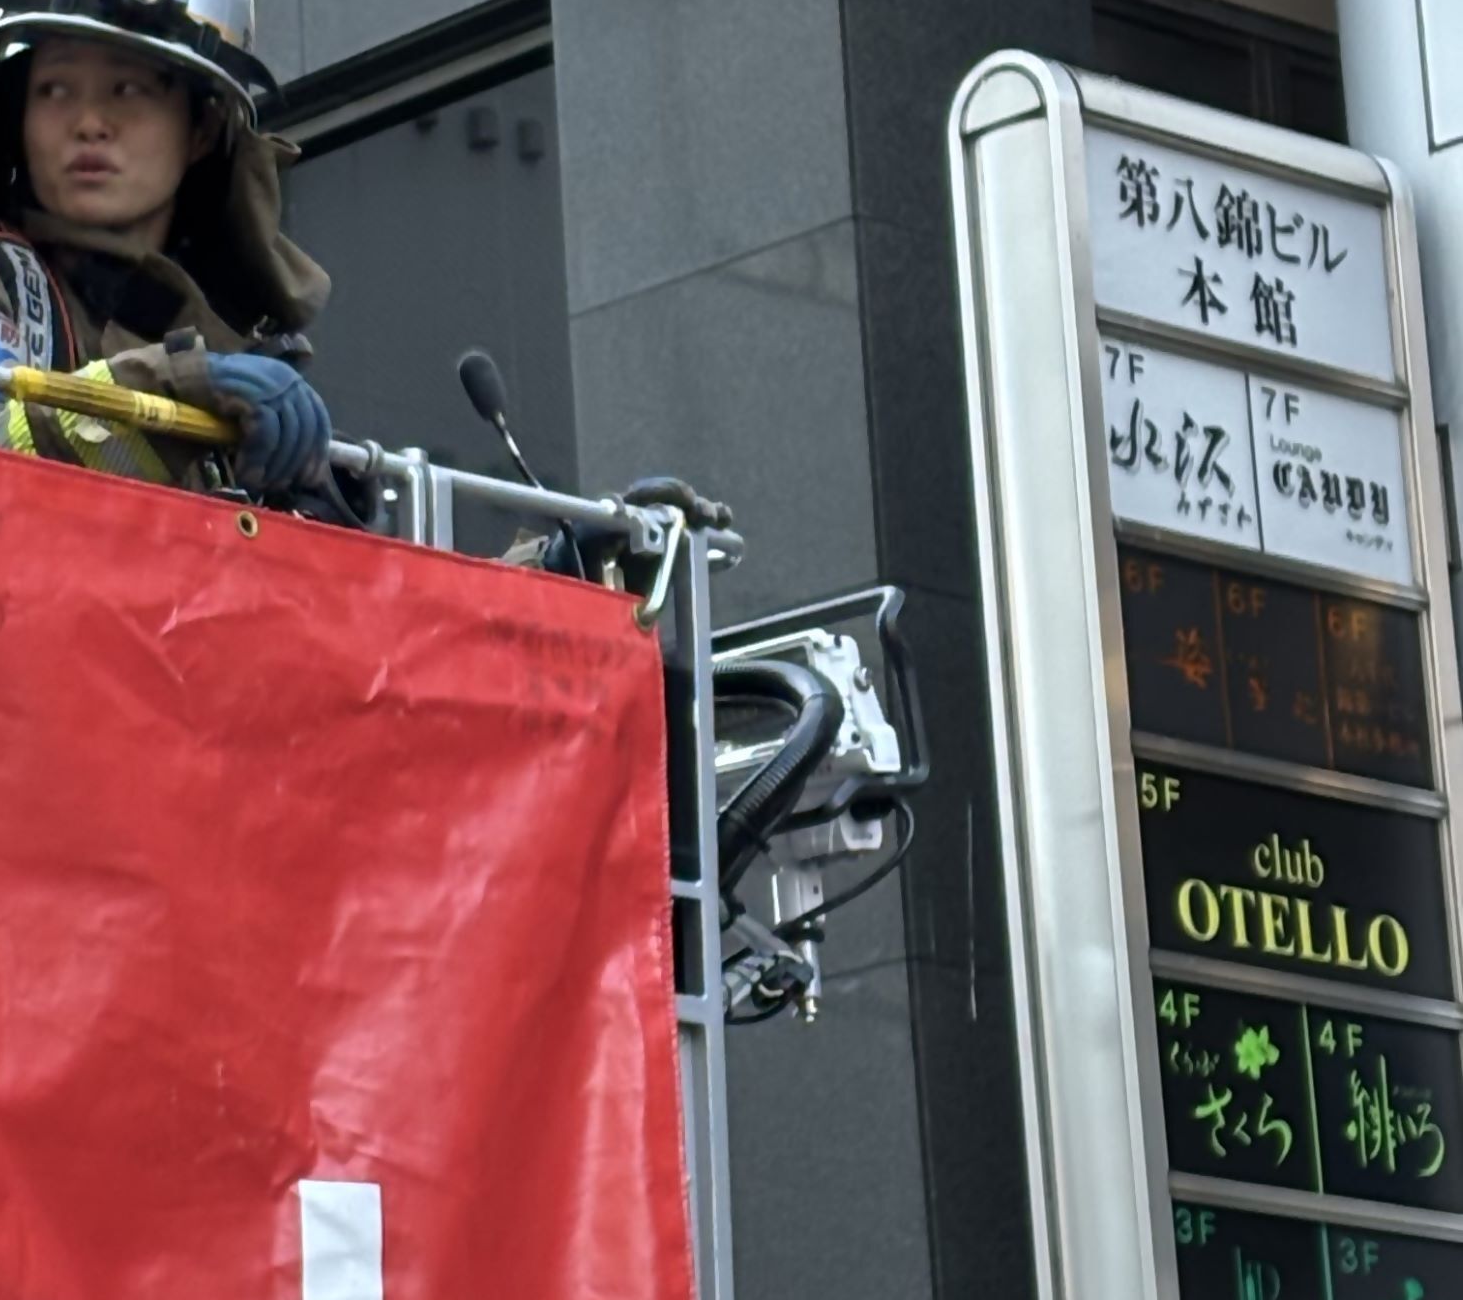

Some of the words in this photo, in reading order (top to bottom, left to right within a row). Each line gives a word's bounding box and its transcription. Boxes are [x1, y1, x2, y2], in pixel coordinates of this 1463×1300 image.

[1116, 154, 1348, 273] 第八錦ビル
[1179, 256, 1298, 348] 本館
[1105, 348, 1145, 386] 7F
[1261, 387, 1300, 426] 7F
[1227, 582, 1268, 617] 6F
[1327, 605, 1369, 642] 6F
[1141, 774, 1181, 810] 5F
[1254, 832, 1325, 888] club
[1177, 877, 1411, 979] OTELLO
[1159, 988, 1200, 1028] 4F
[1318, 1019, 1364, 1058] 4F
[1194, 1082, 1293, 1167] さくら
[1175, 1207, 1216, 1245] 3F
[1340, 1236, 1380, 1276] 3F
